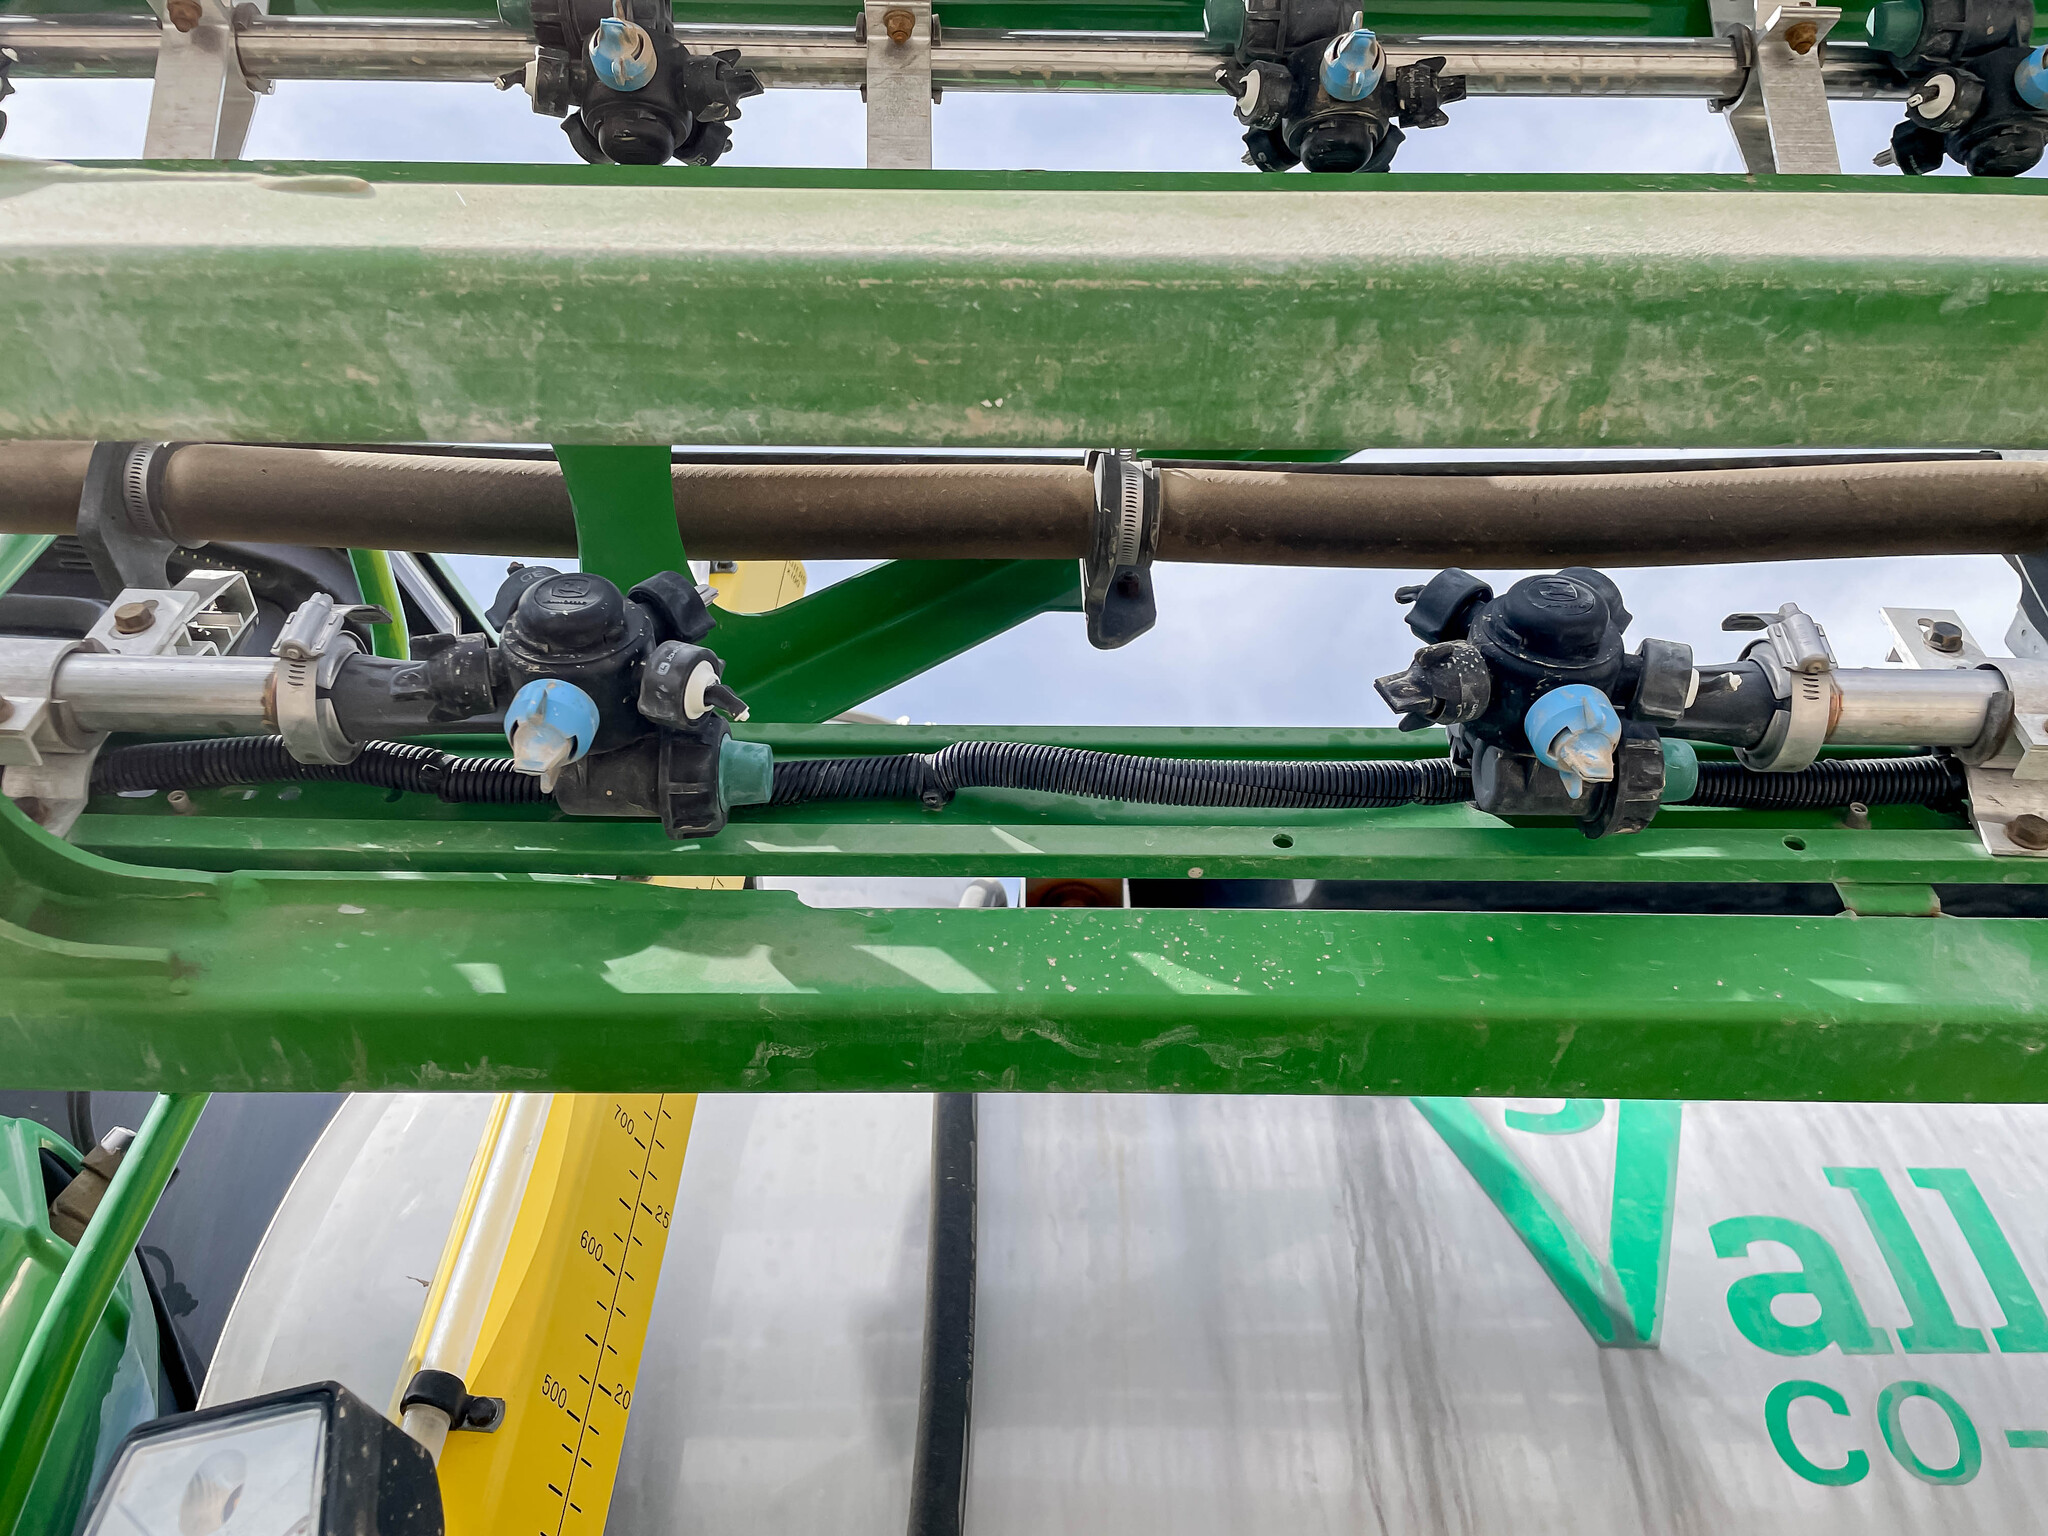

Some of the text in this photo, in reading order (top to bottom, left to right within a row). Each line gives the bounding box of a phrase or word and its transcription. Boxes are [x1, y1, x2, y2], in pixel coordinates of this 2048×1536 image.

[613, 1104, 635, 1135] 700
[654, 1204, 671, 1229] 25
[579, 1230, 604, 1262] 600
[541, 1374, 567, 1409] 500
[613, 1383, 631, 1410] 20
